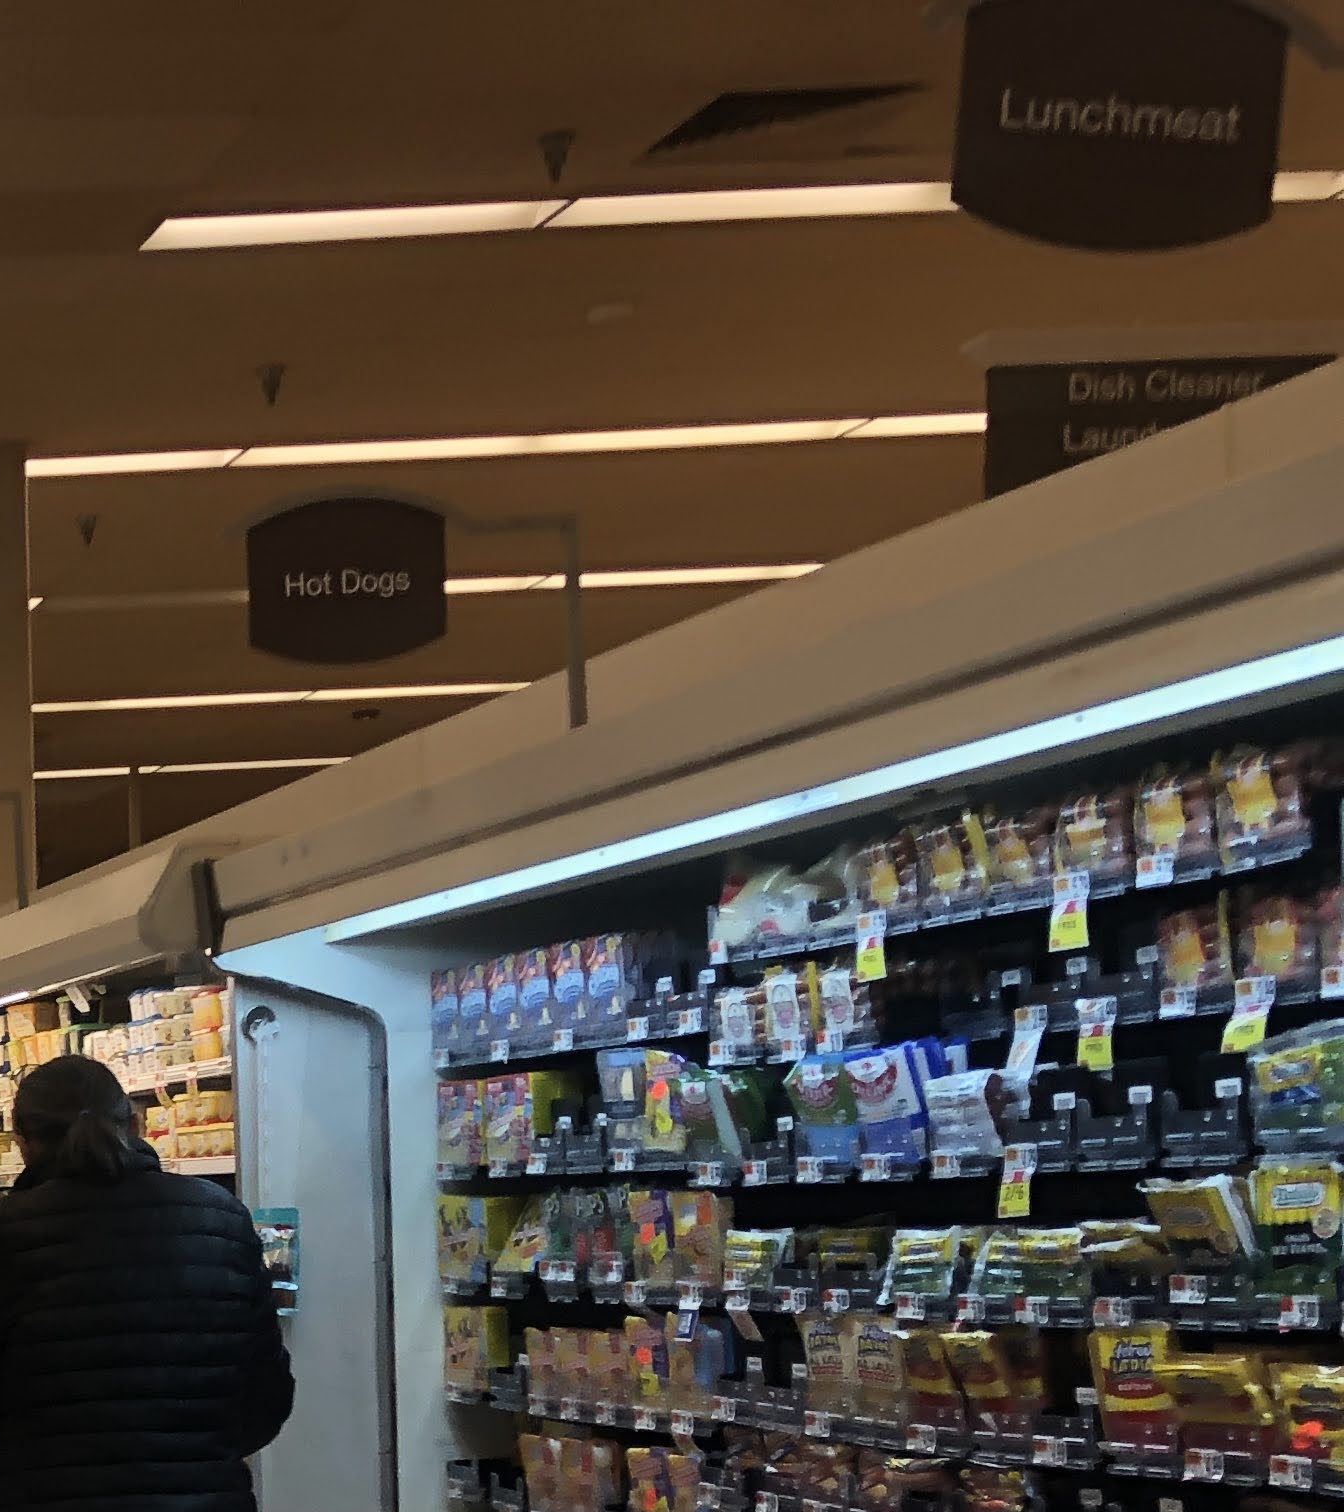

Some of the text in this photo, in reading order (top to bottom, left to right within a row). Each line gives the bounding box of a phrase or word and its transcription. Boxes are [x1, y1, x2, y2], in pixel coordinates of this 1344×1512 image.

[999, 87, 1242, 145] Lunchmeat
[1068, 370, 1136, 401] Dish
[284, 568, 411, 598] Hot Dogs
